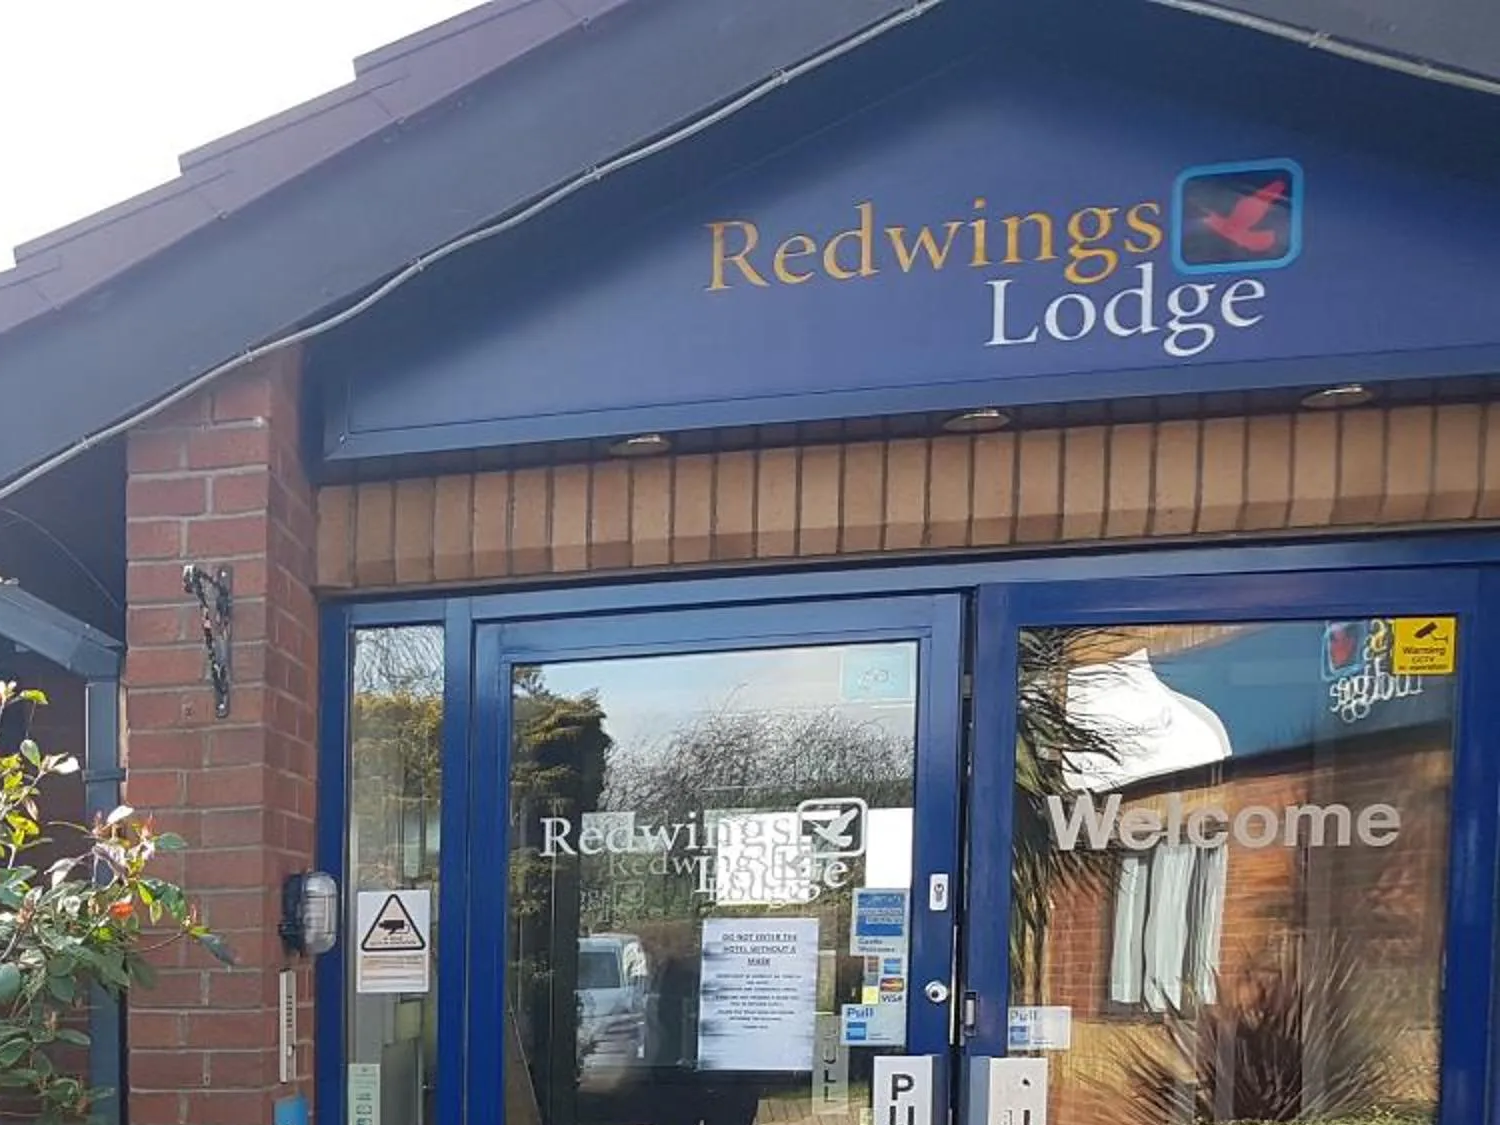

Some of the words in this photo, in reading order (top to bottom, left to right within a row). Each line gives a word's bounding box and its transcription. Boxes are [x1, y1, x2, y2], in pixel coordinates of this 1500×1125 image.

[705, 198, 1164, 293] Redwings
[985, 262, 1267, 357] Lodge
[539, 811, 791, 858] Redwings
[1047, 793, 1401, 851] Welcome
[847, 1007, 874, 1019] Pull
[1009, 1009, 1039, 1021] Pull
